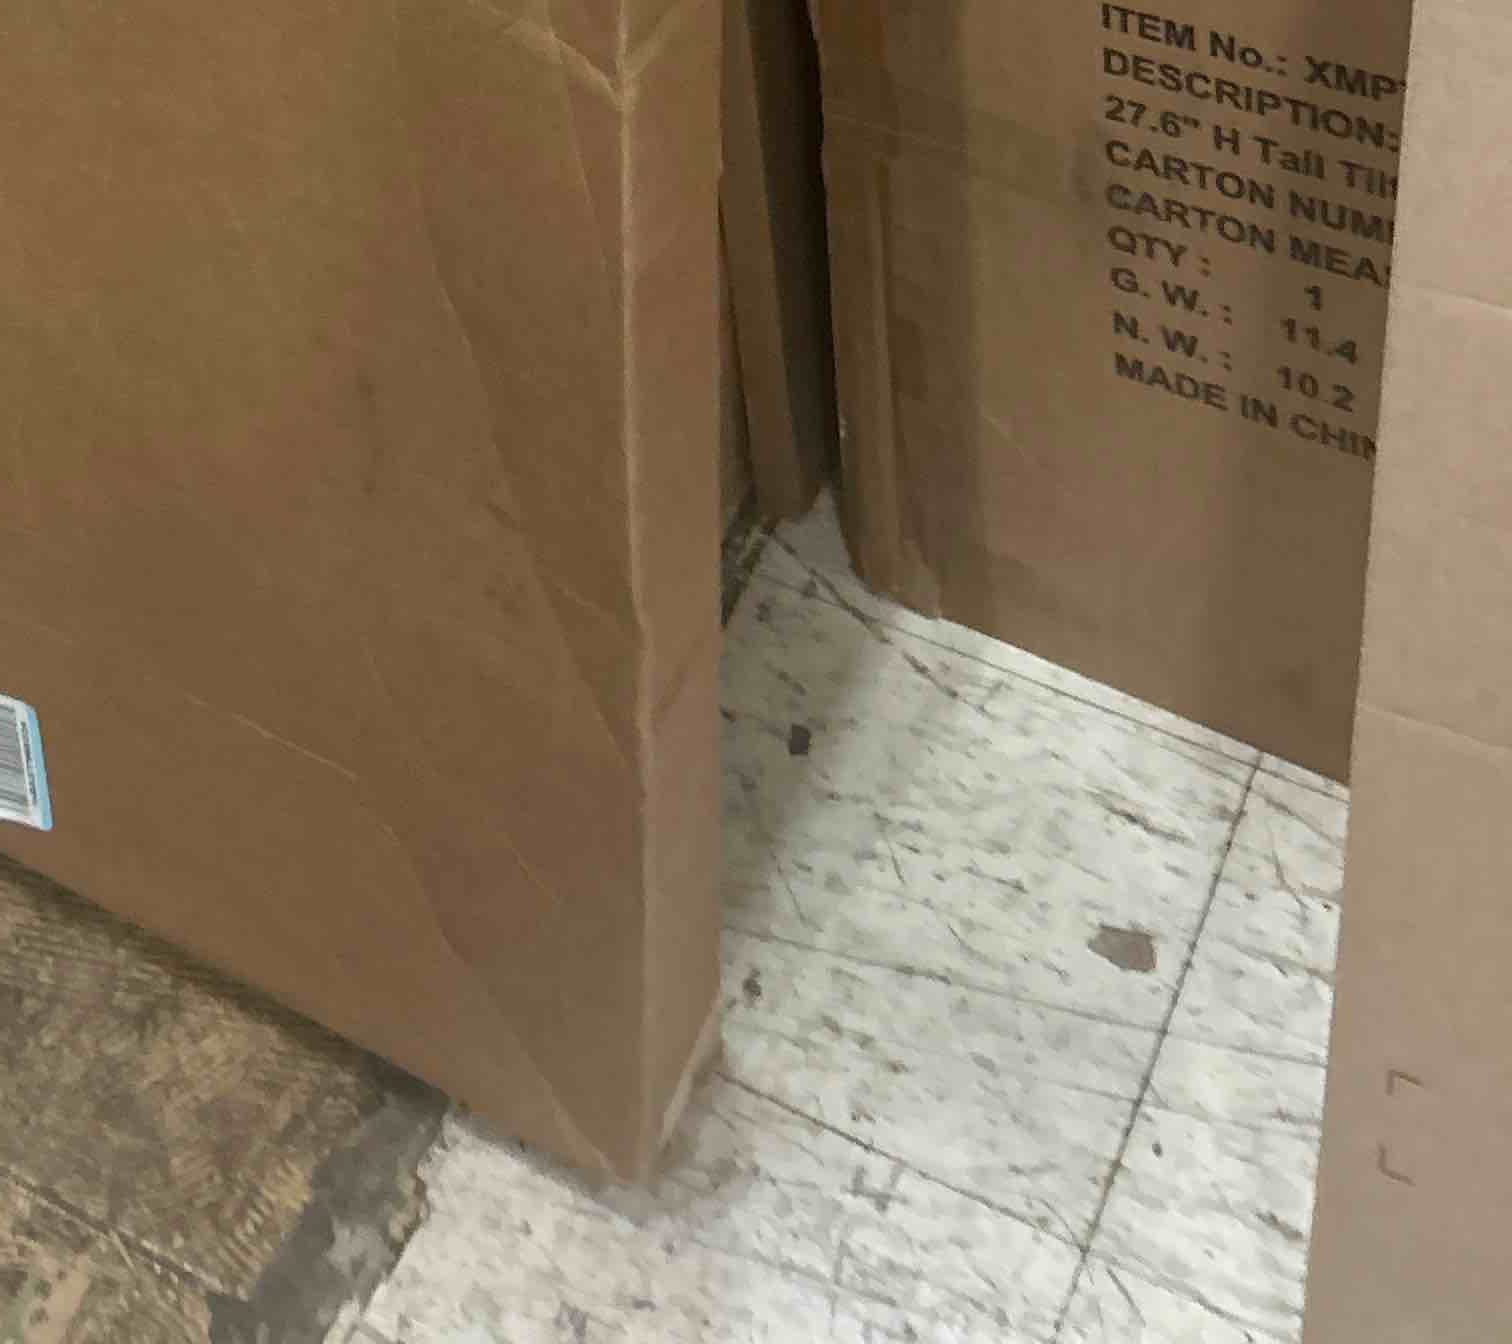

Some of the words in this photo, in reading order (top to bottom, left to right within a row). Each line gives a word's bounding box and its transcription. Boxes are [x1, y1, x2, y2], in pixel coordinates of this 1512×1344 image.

[1100, 2, 1198, 53] ITEM
[1209, 30, 1288, 77] No.:
[1304, 55, 1407, 101] XMP
[1213, 125, 1241, 155] H
[1253, 135, 1326, 180] Tall
[1105, 140, 1275, 210] CARTON
[1288, 190, 1394, 245] NUM
[1105, 183, 1276, 254] CARTON
[1106, 224, 1188, 269] QTY
[1304, 285, 1322, 311] 1
[1279, 317, 1359, 366] 11.4
[1114, 351, 1230, 412] MADE
[1240, 392, 1279, 429] IN
[1276, 364, 1356, 413] 10.2
